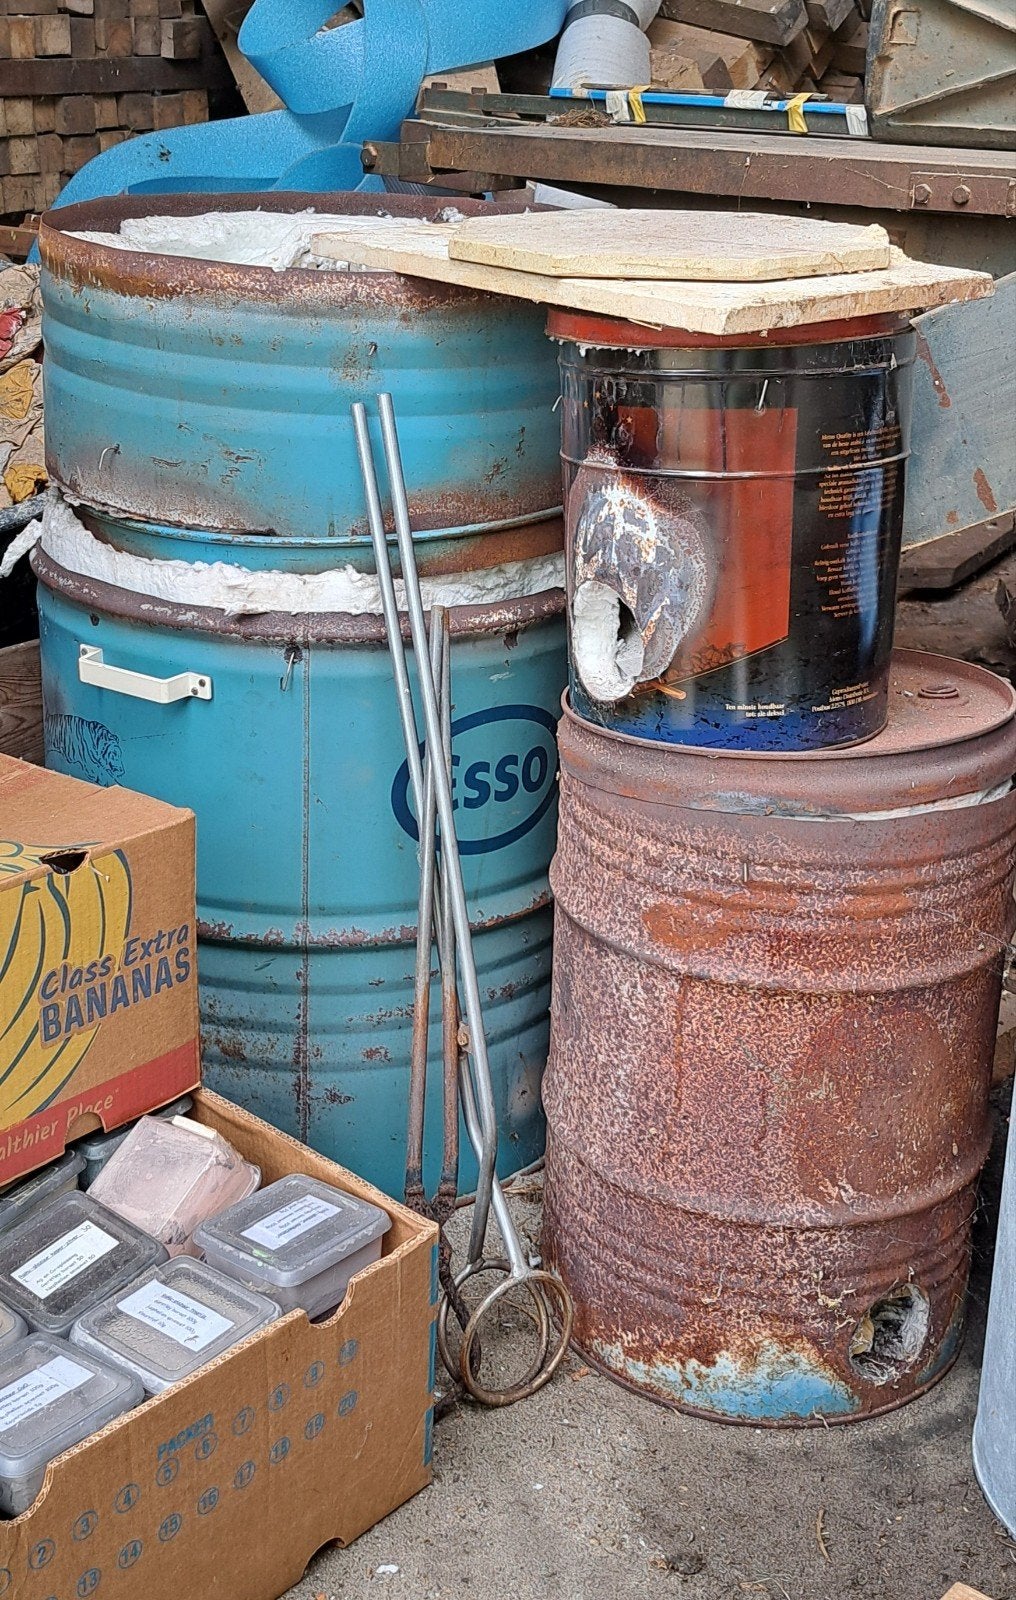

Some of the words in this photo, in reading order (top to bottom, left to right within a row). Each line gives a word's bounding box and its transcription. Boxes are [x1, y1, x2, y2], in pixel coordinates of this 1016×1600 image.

[40, 955, 112, 1000] Class
[124, 923, 189, 966] Extra
[41, 947, 191, 1043] BANANAS
[340, 1392, 356, 1412] 20
[306, 1416, 323, 1435] 19
[272, 1439, 288, 1459] 18
[237, 1464, 253, 1484] 17
[200, 1491, 216, 1510] 16
[120, 1543, 139, 1564] 14
[78, 1571, 98, 1592] 13
